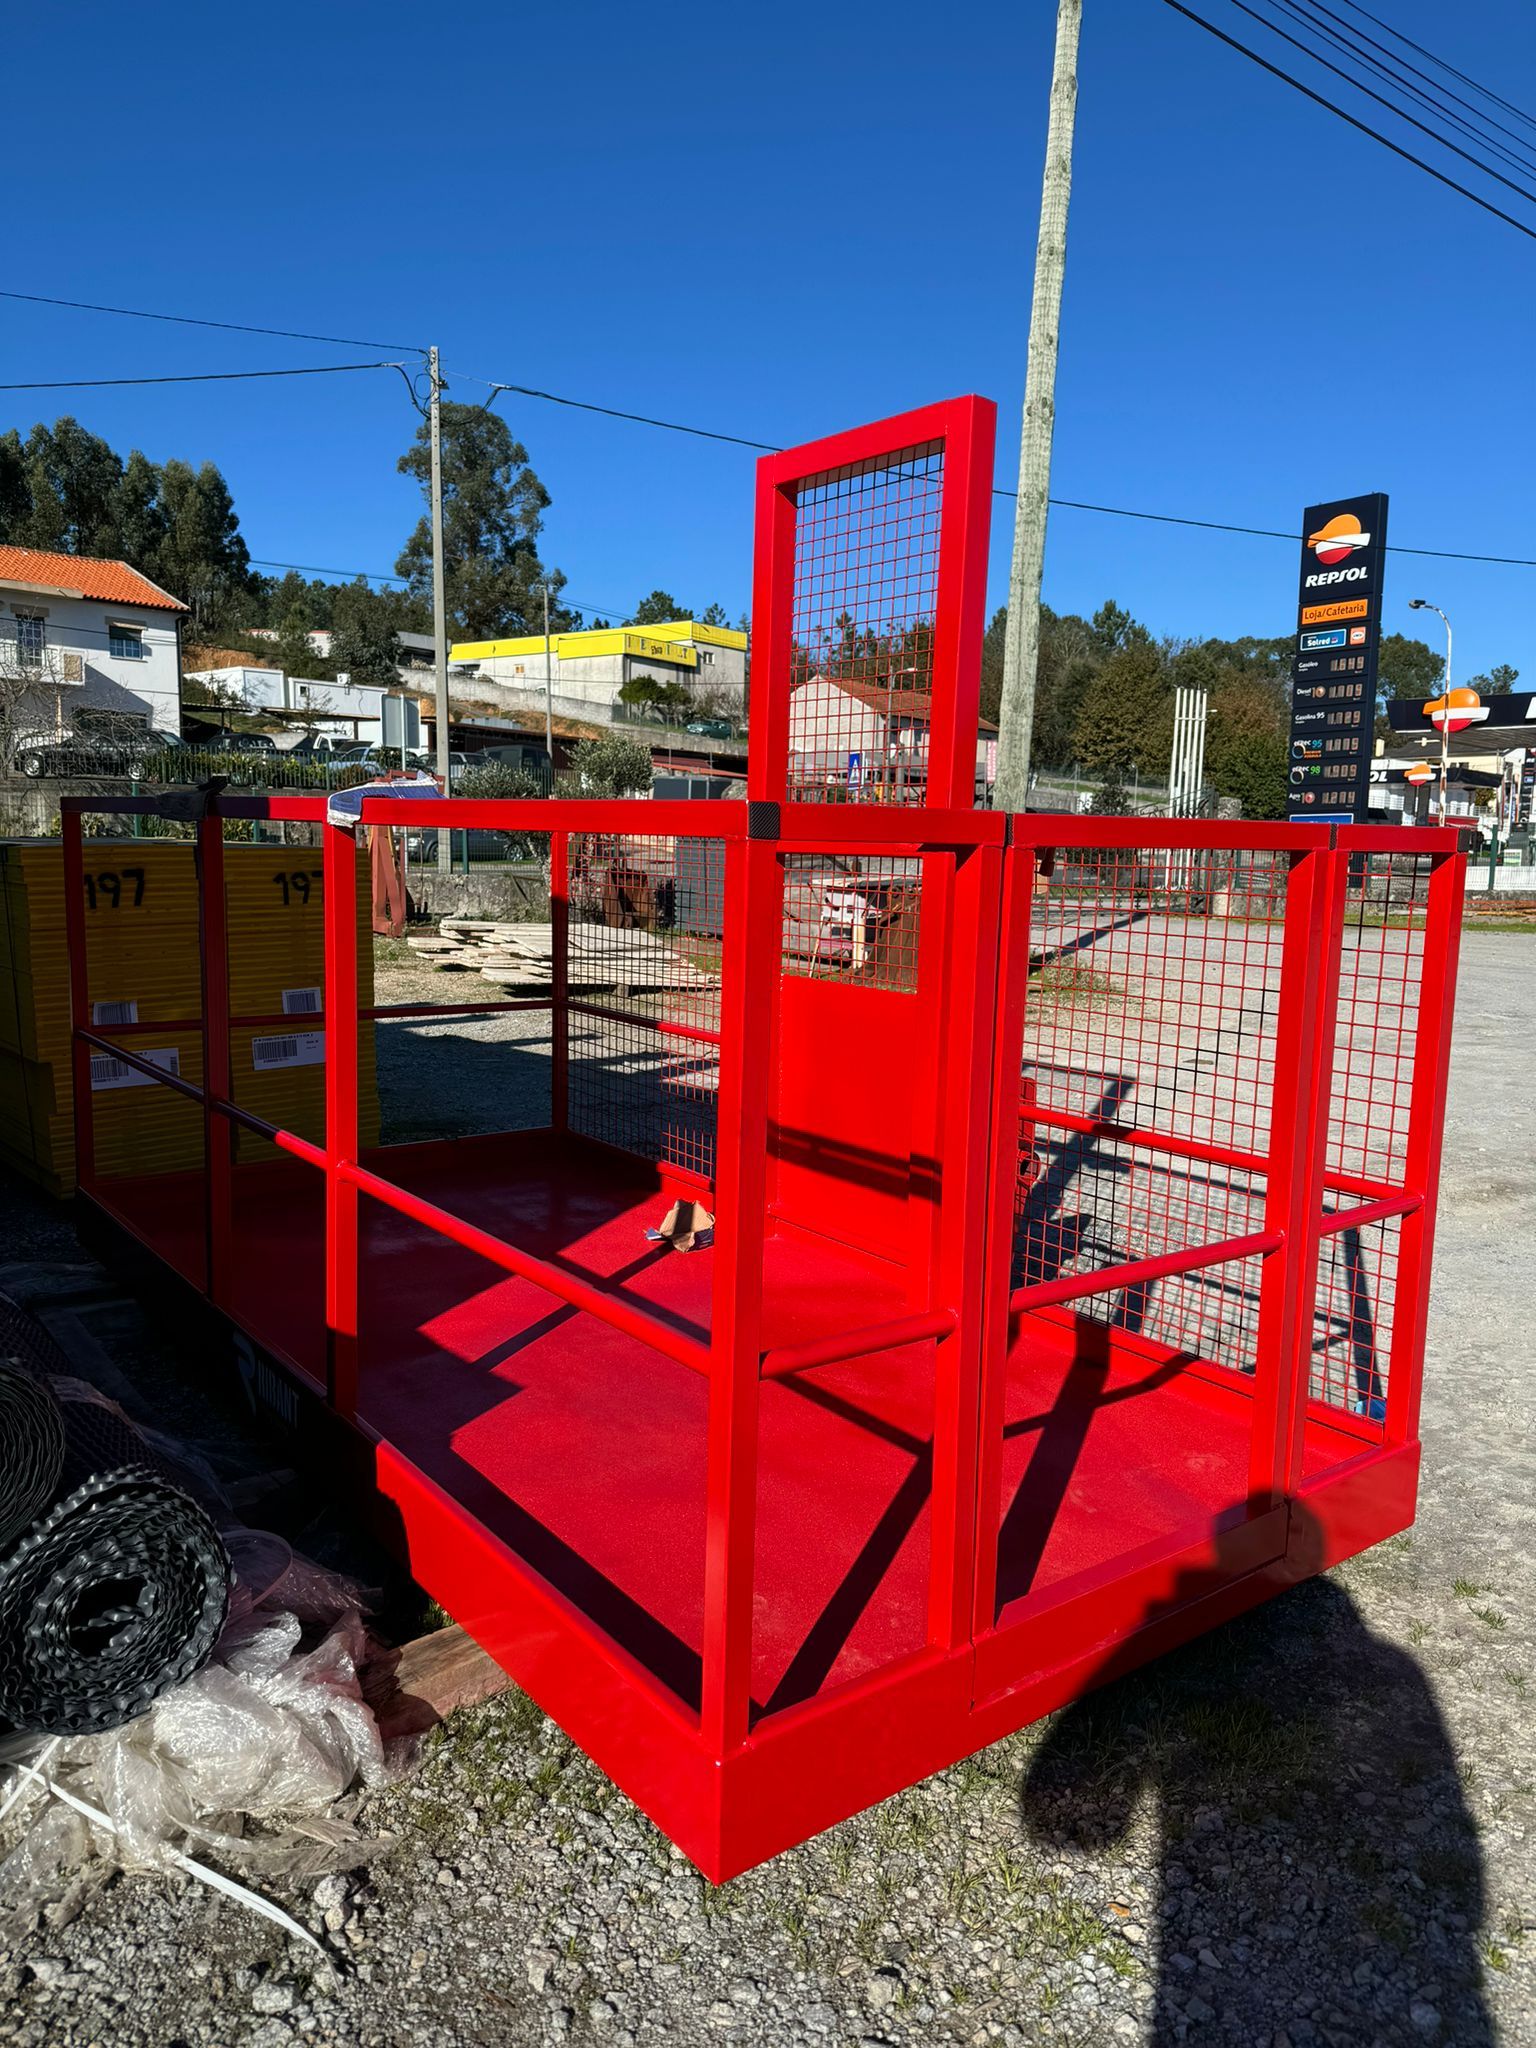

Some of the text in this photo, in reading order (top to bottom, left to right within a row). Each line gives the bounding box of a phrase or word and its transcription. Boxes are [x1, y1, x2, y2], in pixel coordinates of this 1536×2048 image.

[1305, 567, 1368, 587] REPSOL
[1304, 603, 1365, 620] Loja/Cafetaria
[1307, 637, 1331, 647] Solred
[1316, 711, 1325, 719] 95
[1312, 739, 1322, 748] 95
[1310, 765, 1321, 774] 98
[83, 868, 145, 910] 197
